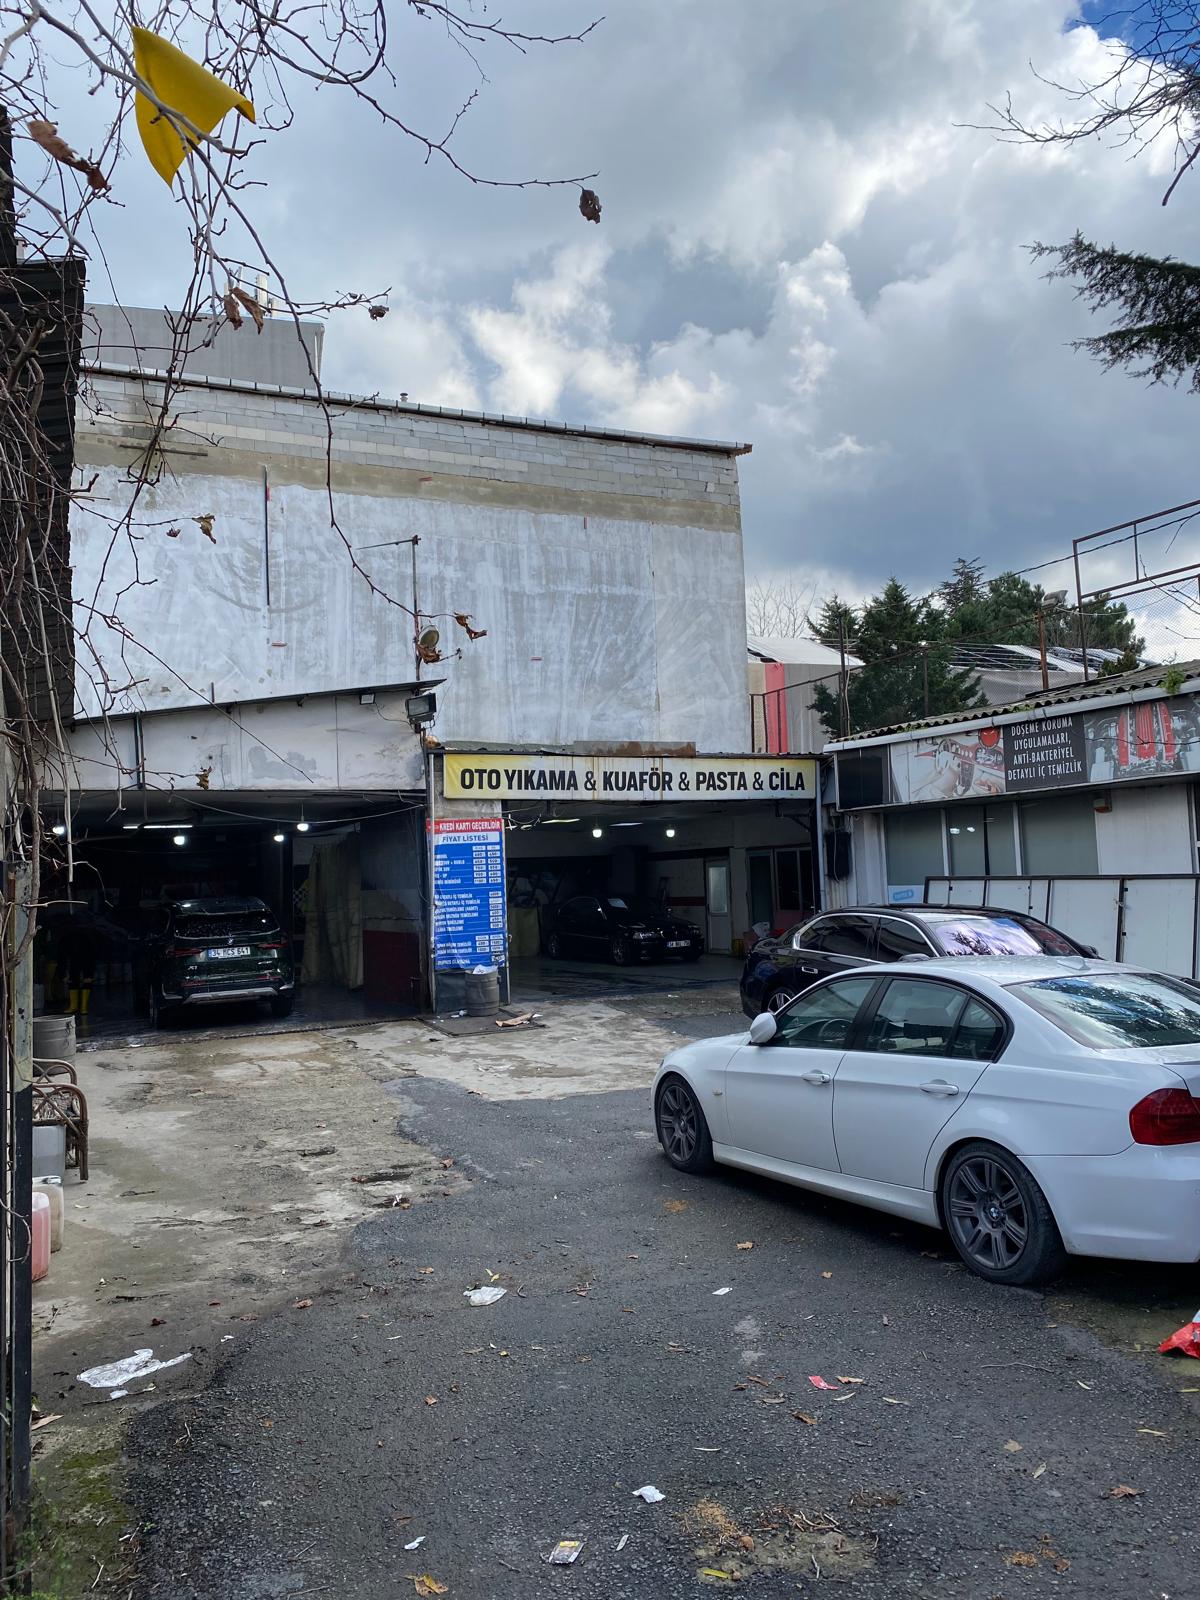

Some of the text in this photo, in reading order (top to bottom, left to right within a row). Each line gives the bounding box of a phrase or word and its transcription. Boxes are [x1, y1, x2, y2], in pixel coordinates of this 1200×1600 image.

[1042, 716, 1073, 731] KORUMA
[1014, 732, 1071, 750] UYGULAMALARI,
[1013, 746, 1074, 766] ANTİ-BAKTERİYEL
[1007, 760, 1082, 780] DETAYLI İÇ TEMİZLİK
[460, 766, 805, 792] OTO YIKAMA & KUAFÖR & PASTA & CİLA
[439, 819, 501, 831] KREDİ KARTI GEÇERLİDİR
[442, 834, 488, 843] FİYAT LİSTESİ
[212, 949, 221, 957] 34
